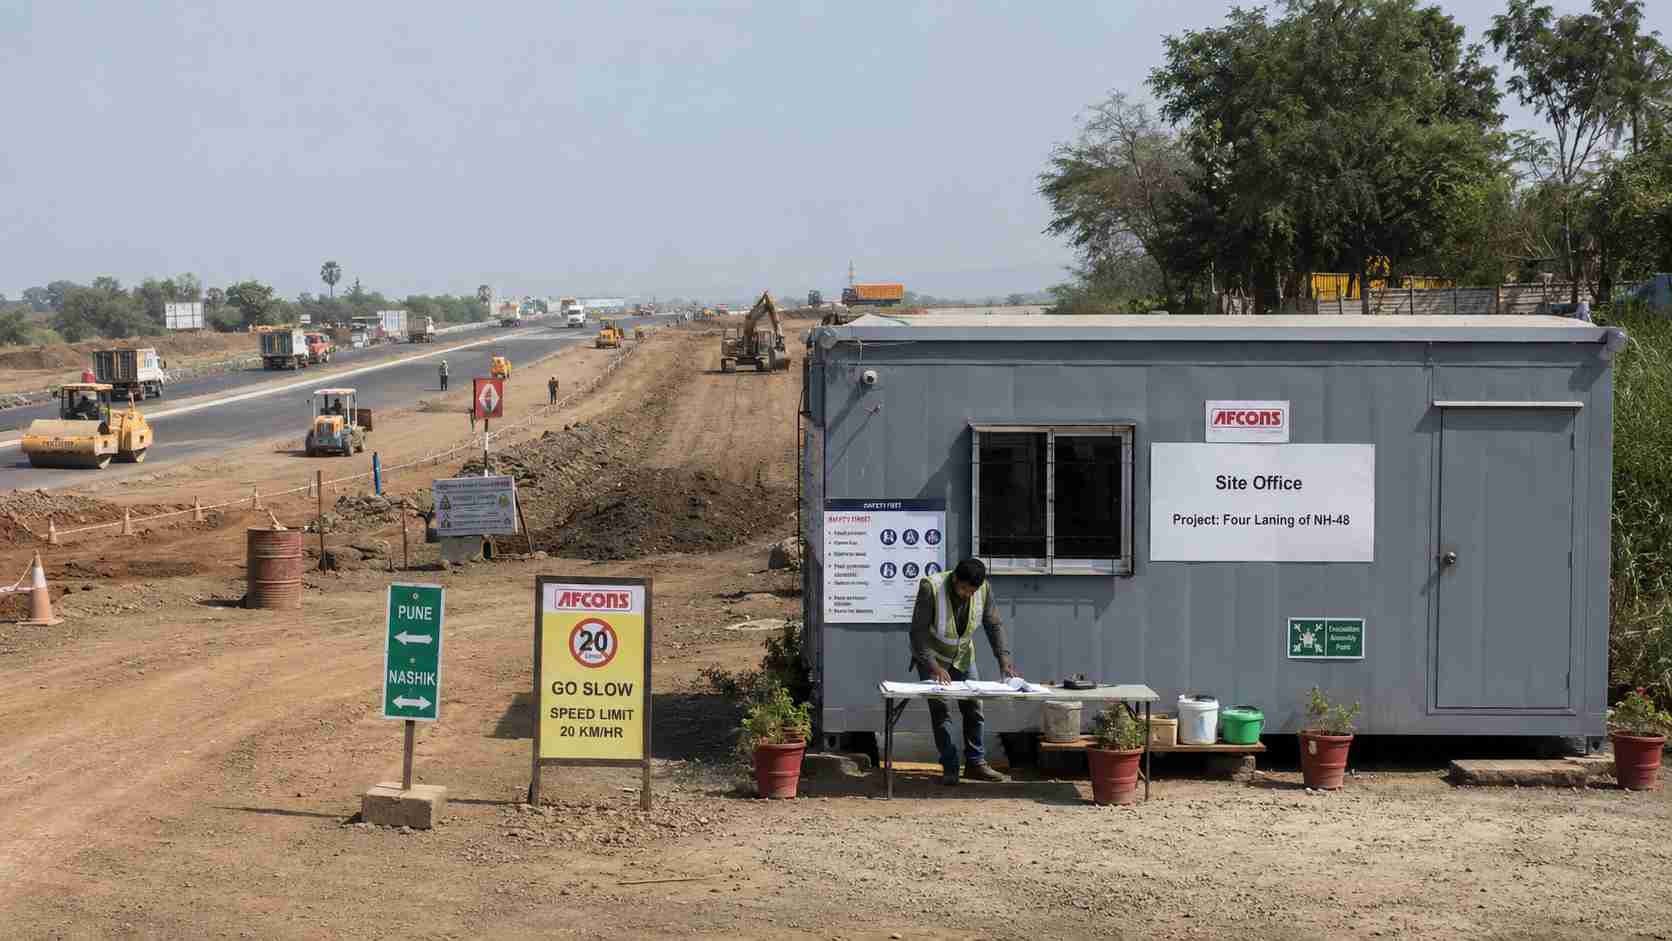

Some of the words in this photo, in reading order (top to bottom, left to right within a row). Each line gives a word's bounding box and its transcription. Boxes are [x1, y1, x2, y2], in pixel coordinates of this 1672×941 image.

[1213, 411, 1281, 425] AFCONS
[1215, 475, 1248, 490] Site
[1253, 475, 1303, 491] Office
[1172, 514, 1220, 528] Project:
[1223, 514, 1251, 526] Four
[1254, 514, 1295, 528] Laning
[1298, 514, 1311, 526] of
[1313, 514, 1351, 526] NH-48
[558, 591, 630, 609] AFCONS
[398, 605, 433, 621] PUNE
[579, 630, 608, 652] 20
[389, 670, 436, 686] NASHIK
[551, 681, 578, 696] GO
[583, 682, 634, 697] SLOW
[550, 707, 596, 720] SPEED
[600, 708, 635, 721] LIMIT
[560, 726, 575, 737] 20
[579, 726, 624, 739] KM/HR
